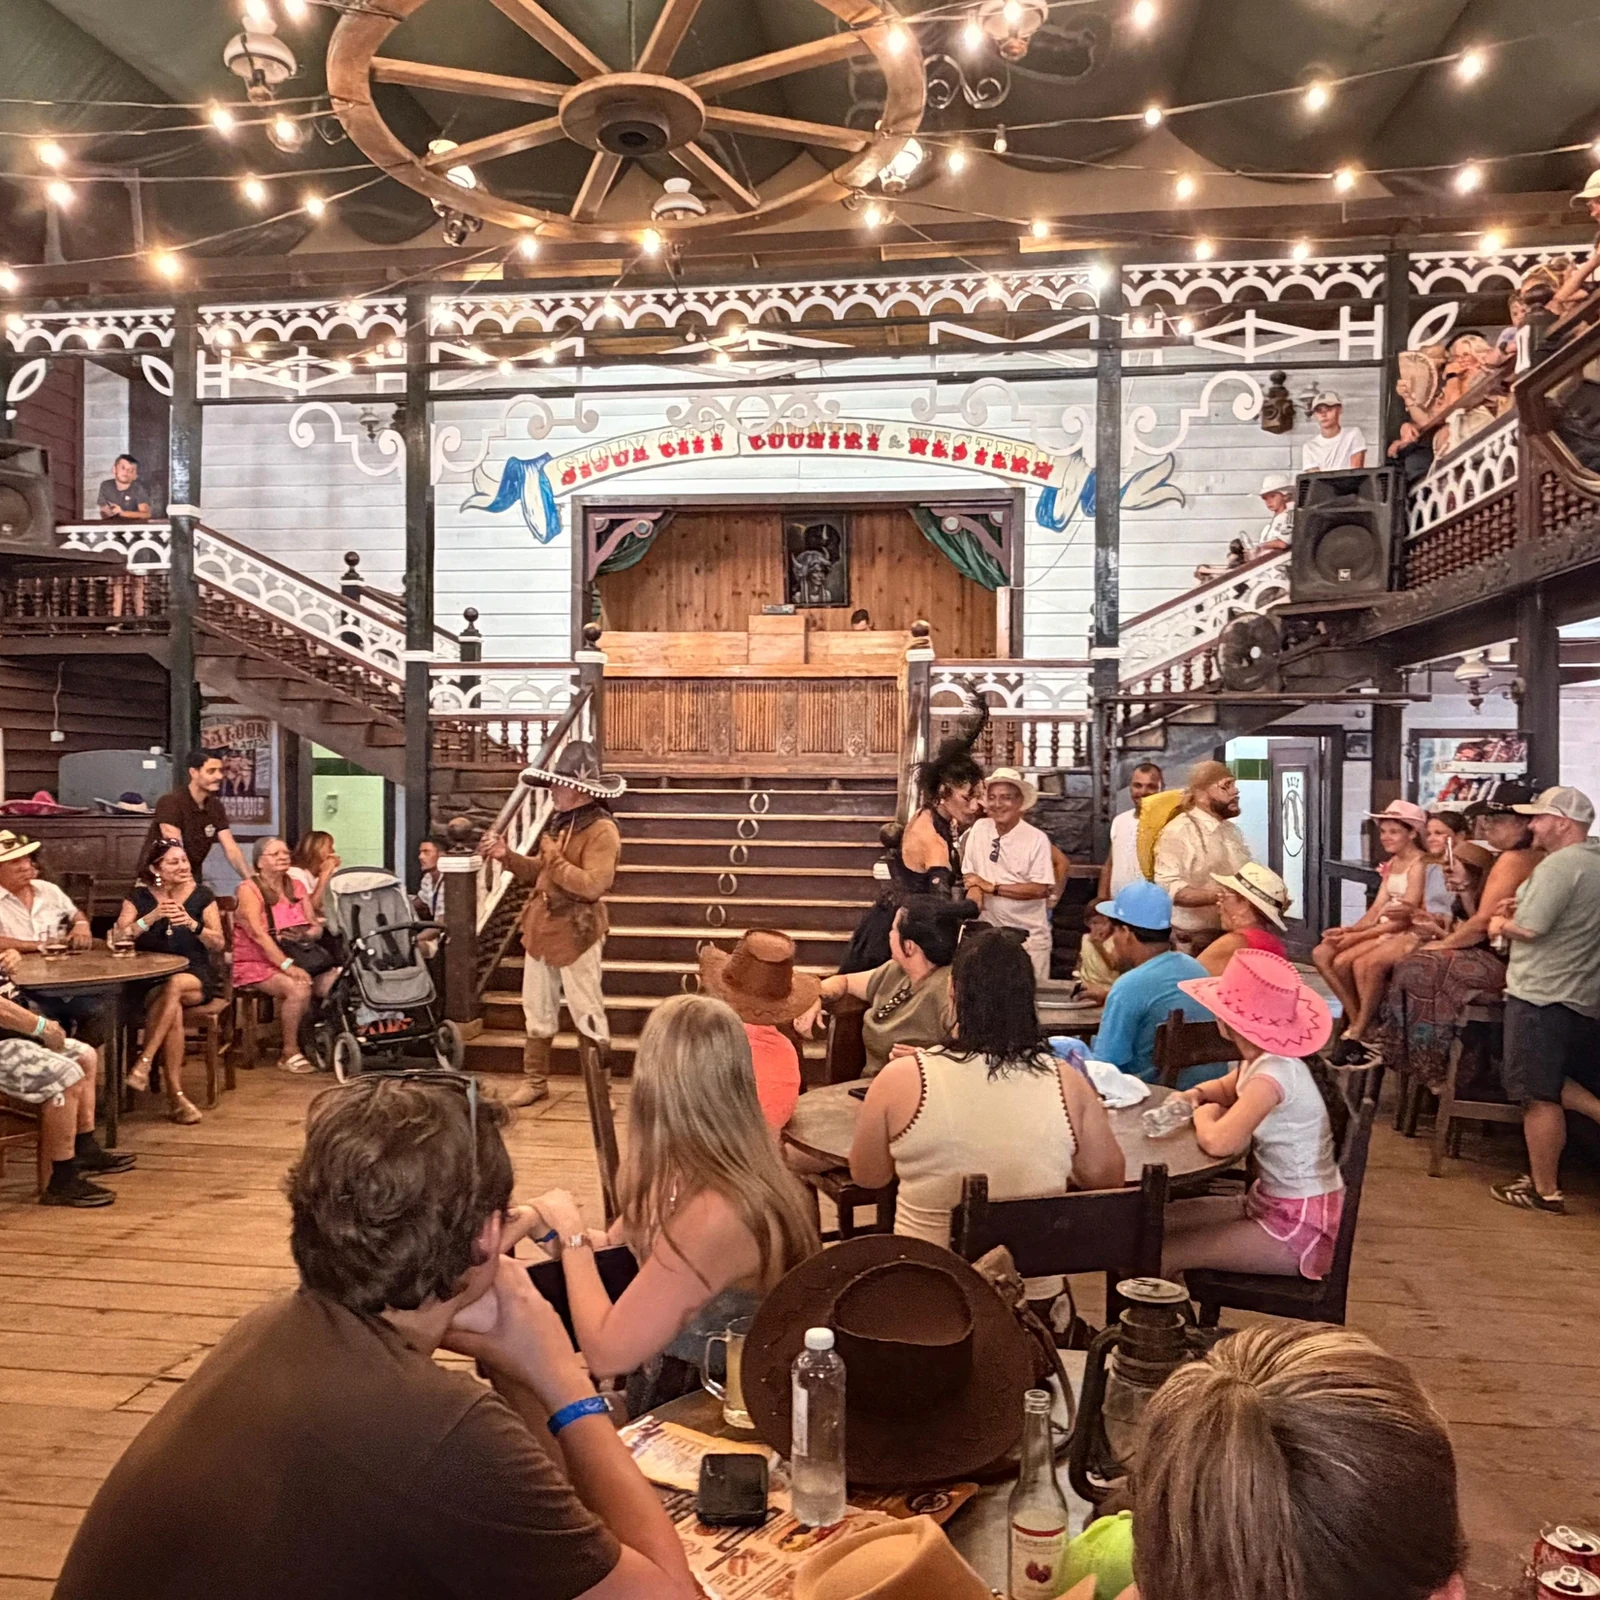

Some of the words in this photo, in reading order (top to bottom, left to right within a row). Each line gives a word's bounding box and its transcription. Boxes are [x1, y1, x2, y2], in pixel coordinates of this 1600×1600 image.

[557, 435, 650, 486] SIOUX
[658, 423, 726, 459] CITY
[748, 421, 885, 452] COUNTRY
[888, 434, 905, 450] &
[908, 427, 1054, 481] WESTERN
